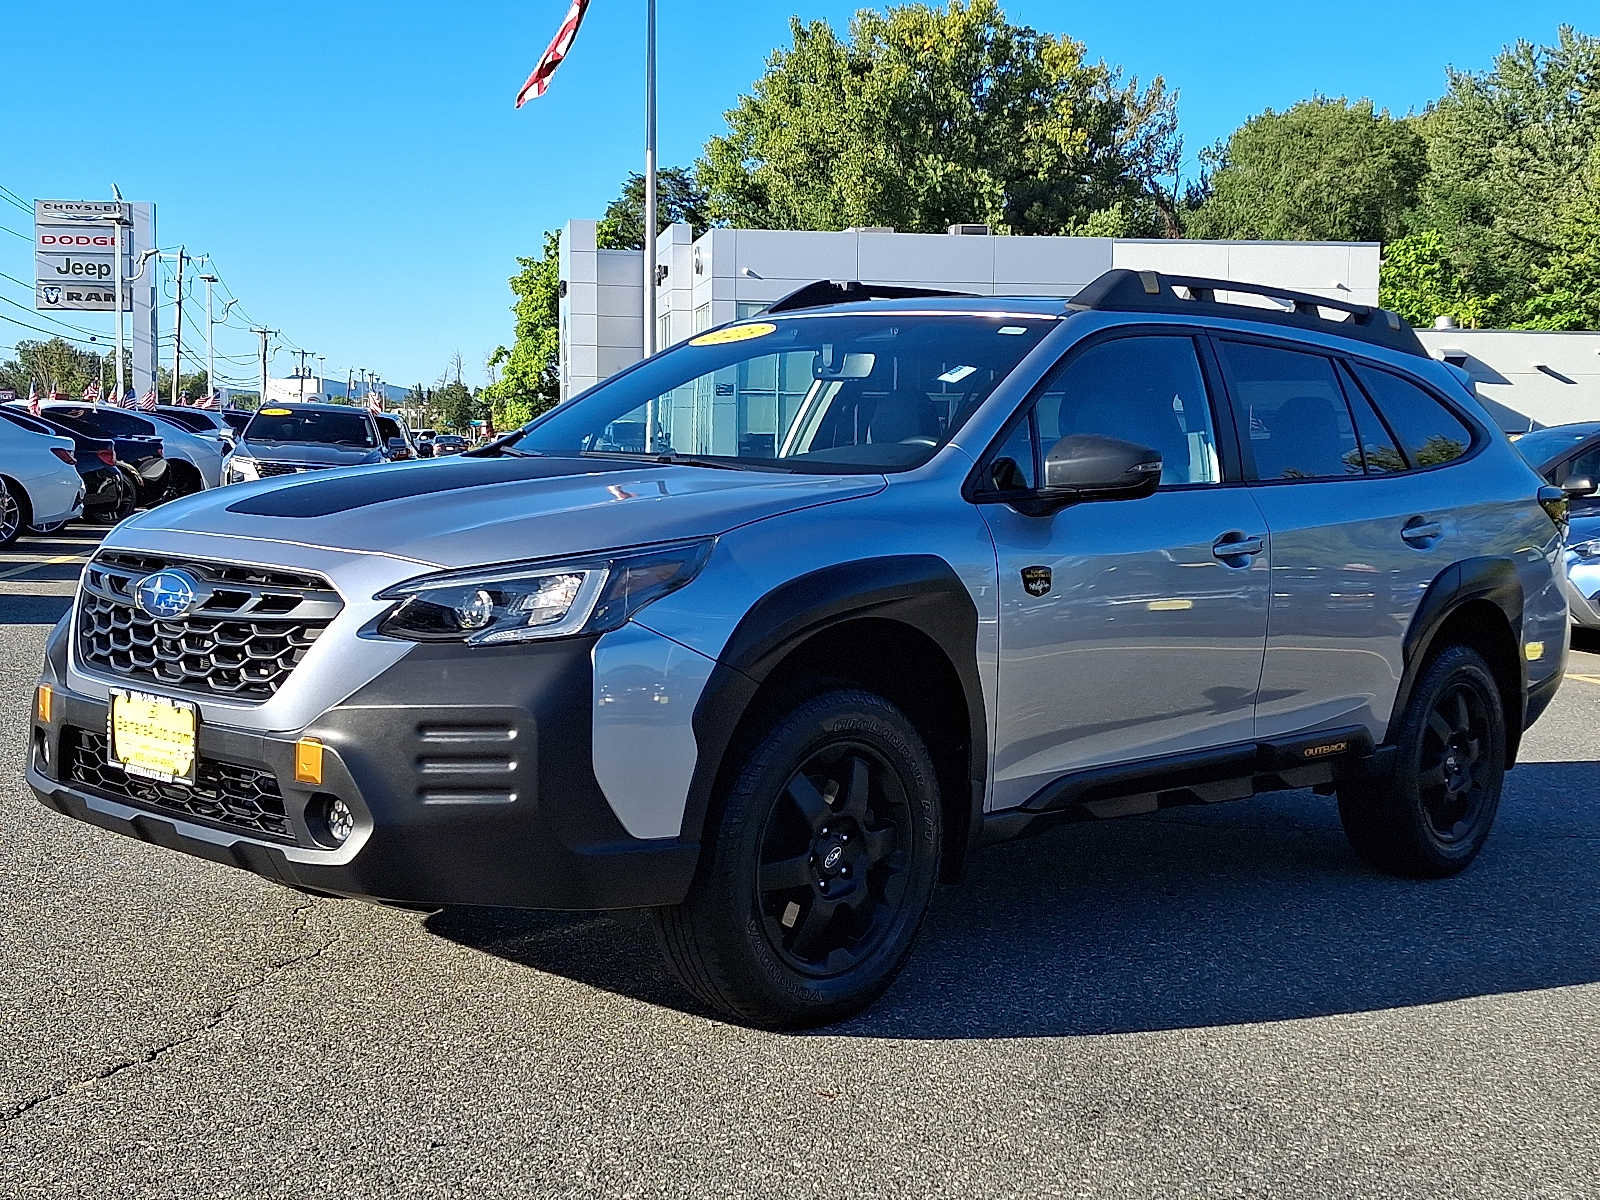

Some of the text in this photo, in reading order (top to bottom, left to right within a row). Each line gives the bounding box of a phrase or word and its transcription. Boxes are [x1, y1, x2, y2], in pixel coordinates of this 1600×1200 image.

[43, 203, 122, 213] CHRYSLER
[56, 257, 111, 279] Jeep
[66, 291, 125, 303] RAM
[1303, 742, 1347, 757] OUTBACK
